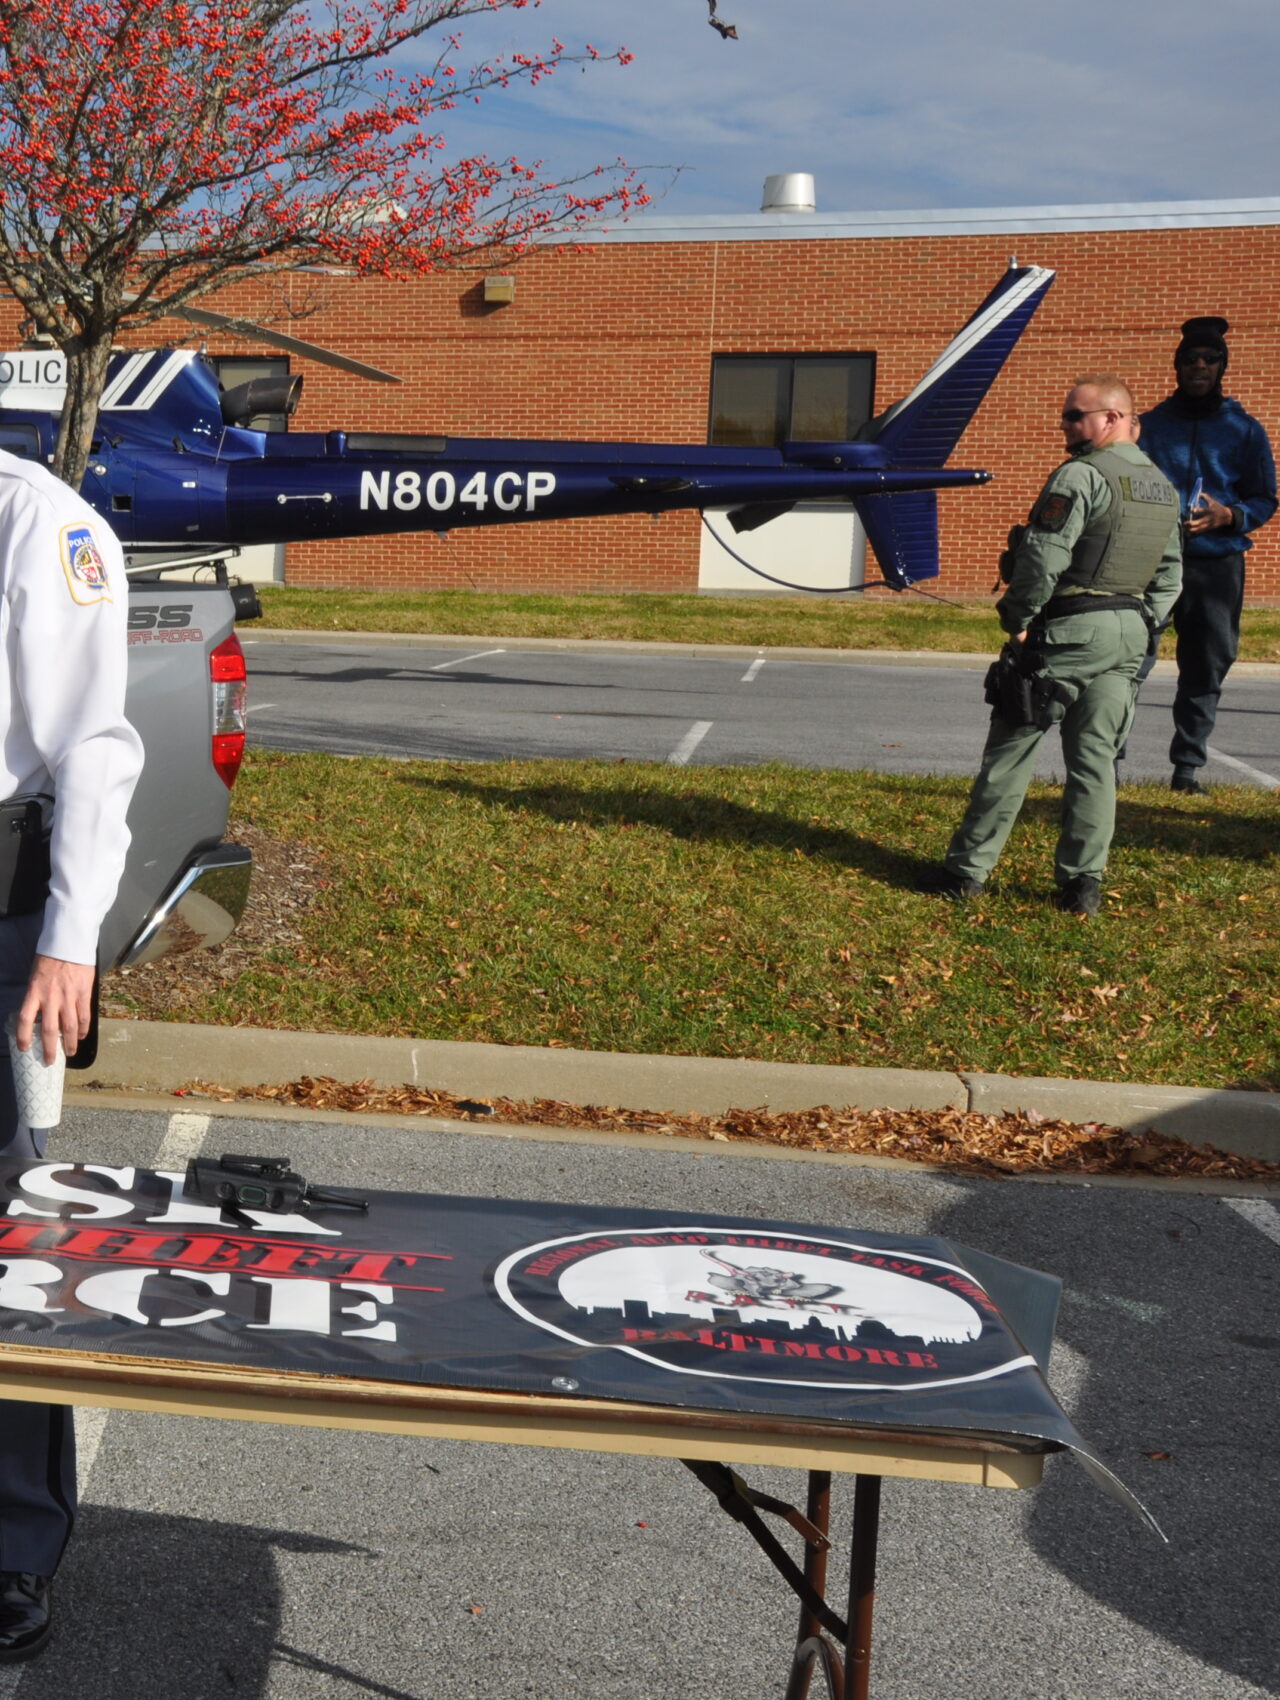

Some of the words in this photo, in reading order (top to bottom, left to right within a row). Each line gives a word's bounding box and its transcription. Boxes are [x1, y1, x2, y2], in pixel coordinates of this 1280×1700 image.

[359, 470, 557, 512] N804CP
[69, 536, 94, 549] POLIC
[524, 1238, 624, 1277] REGIONAL
[628, 1234, 709, 1247] AUTO
[721, 1236, 838, 1255] THEFT
[848, 1251, 929, 1277] TASK
[623, 1327, 940, 1369] BALTIMORE
